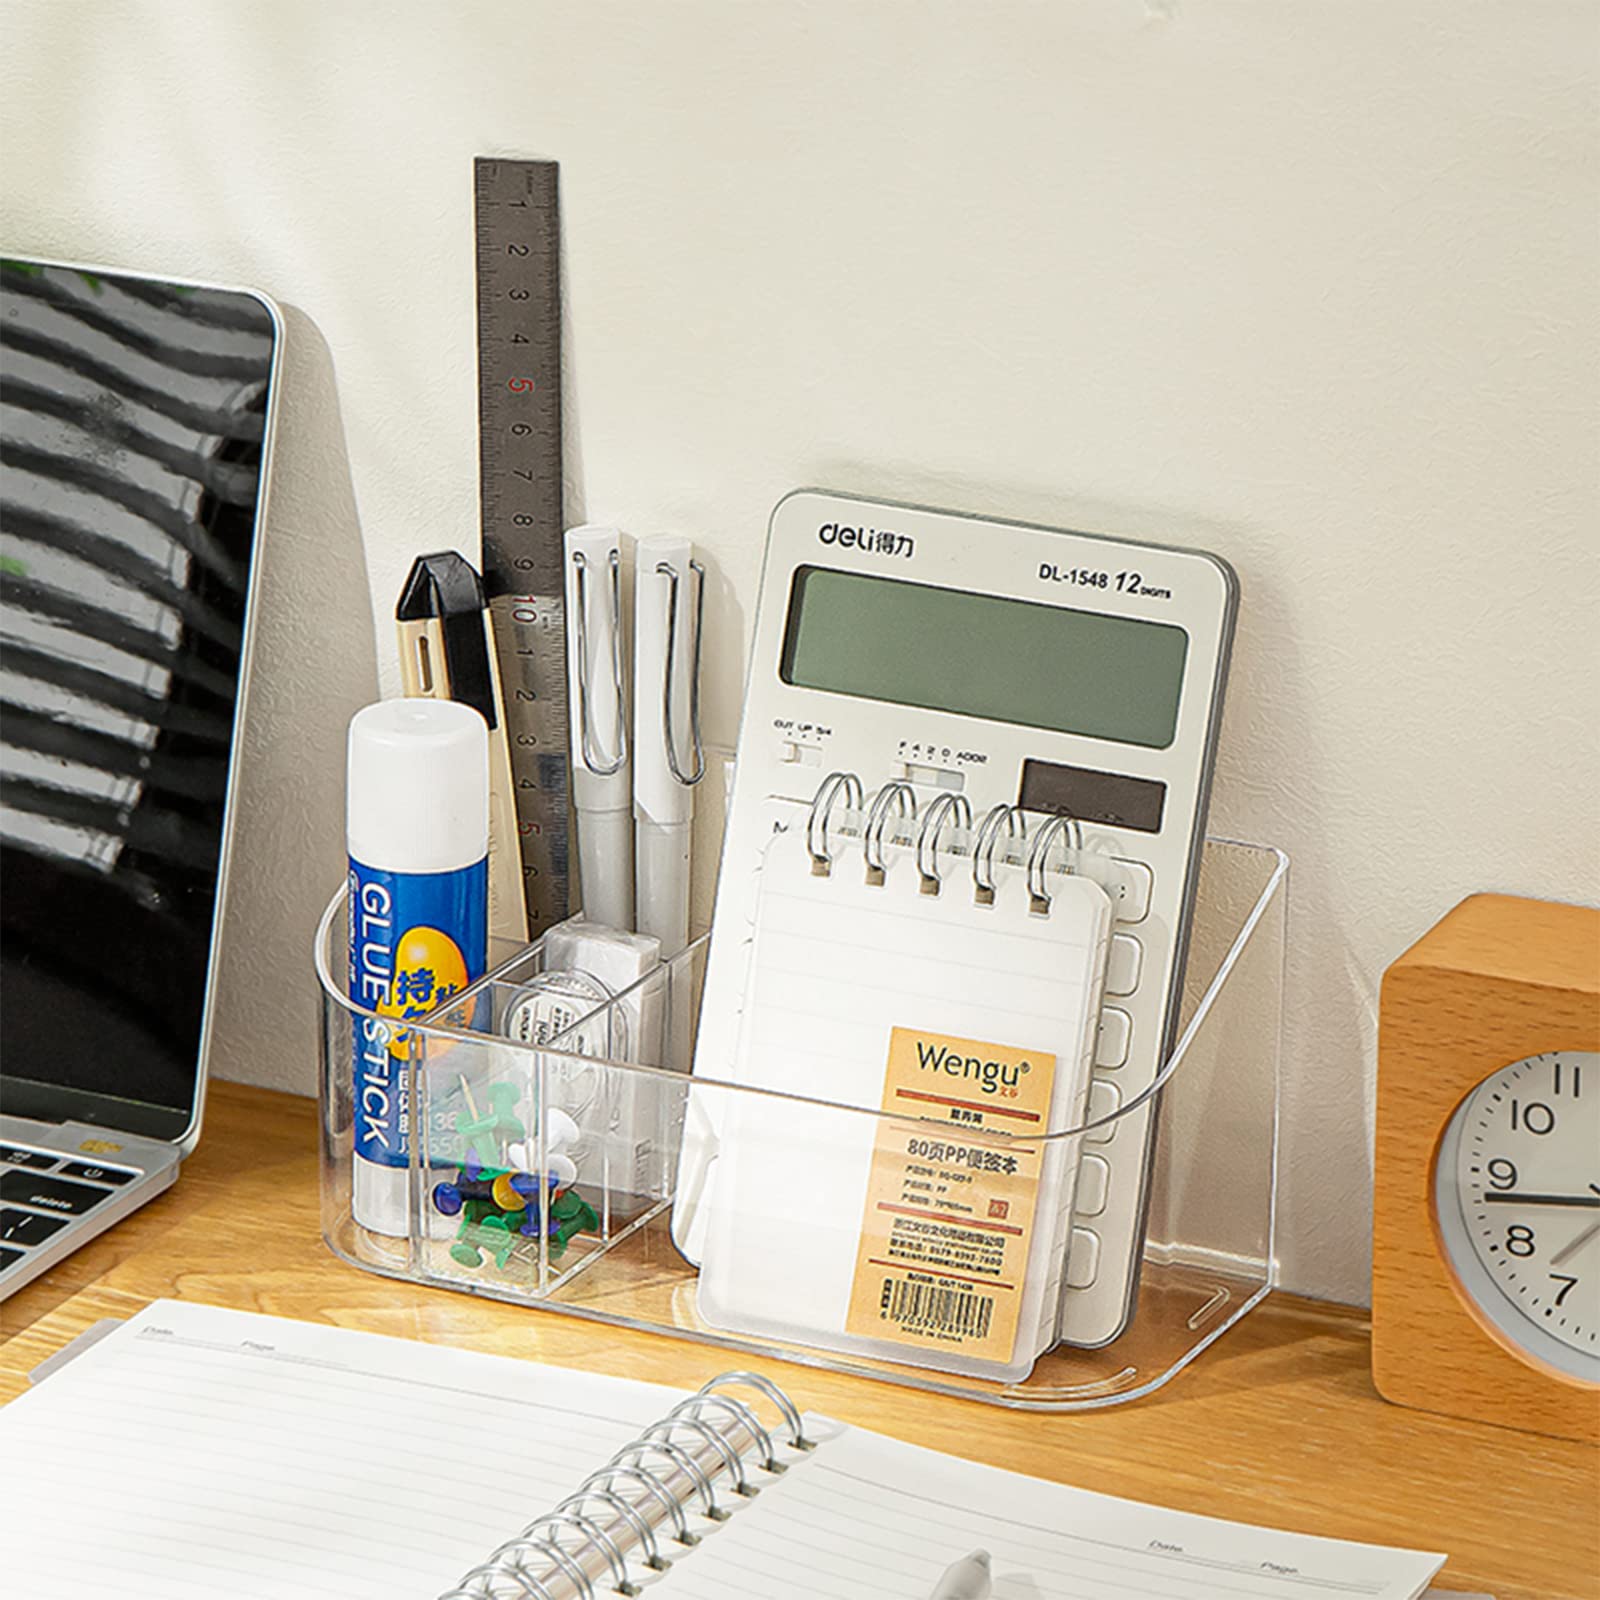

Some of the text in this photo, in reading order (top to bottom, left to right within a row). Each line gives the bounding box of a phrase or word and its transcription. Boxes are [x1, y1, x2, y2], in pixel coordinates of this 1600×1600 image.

[508, 201, 527, 209] 1
[508, 244, 529, 257] 2
[509, 289, 530, 301] 3
[511, 334, 530, 344] 4
[508, 376, 534, 392] 5
[511, 423, 532, 436] 6
[513, 470, 532, 481] 7
[513, 514, 533, 526] 8
[514, 558, 534, 571] 9
[1039, 563, 1108, 589] DL-1548
[1115, 571, 1141, 594] 12
[513, 595, 537, 623] 10
[516, 690, 536, 701] 2
[517, 735, 536, 746] 3
[519, 778, 536, 790] 4
[520, 822, 540, 836] 5
[361, 882, 392, 1149] GLUE STICK
[1555, 1063, 1580, 1098] 11
[1511, 1099, 1555, 1135] 10
[907, 1138, 1018, 1176] 80页PP便签本
[1487, 1158, 1518, 1191] 9
[1505, 1224, 1536, 1258] 8
[1549, 1273, 1579, 1306] 7
[901, 1325, 923, 1336] MADE
[937, 1332, 962, 1343] CHINA
[1149, 1540, 1299, 1574] Date Page
